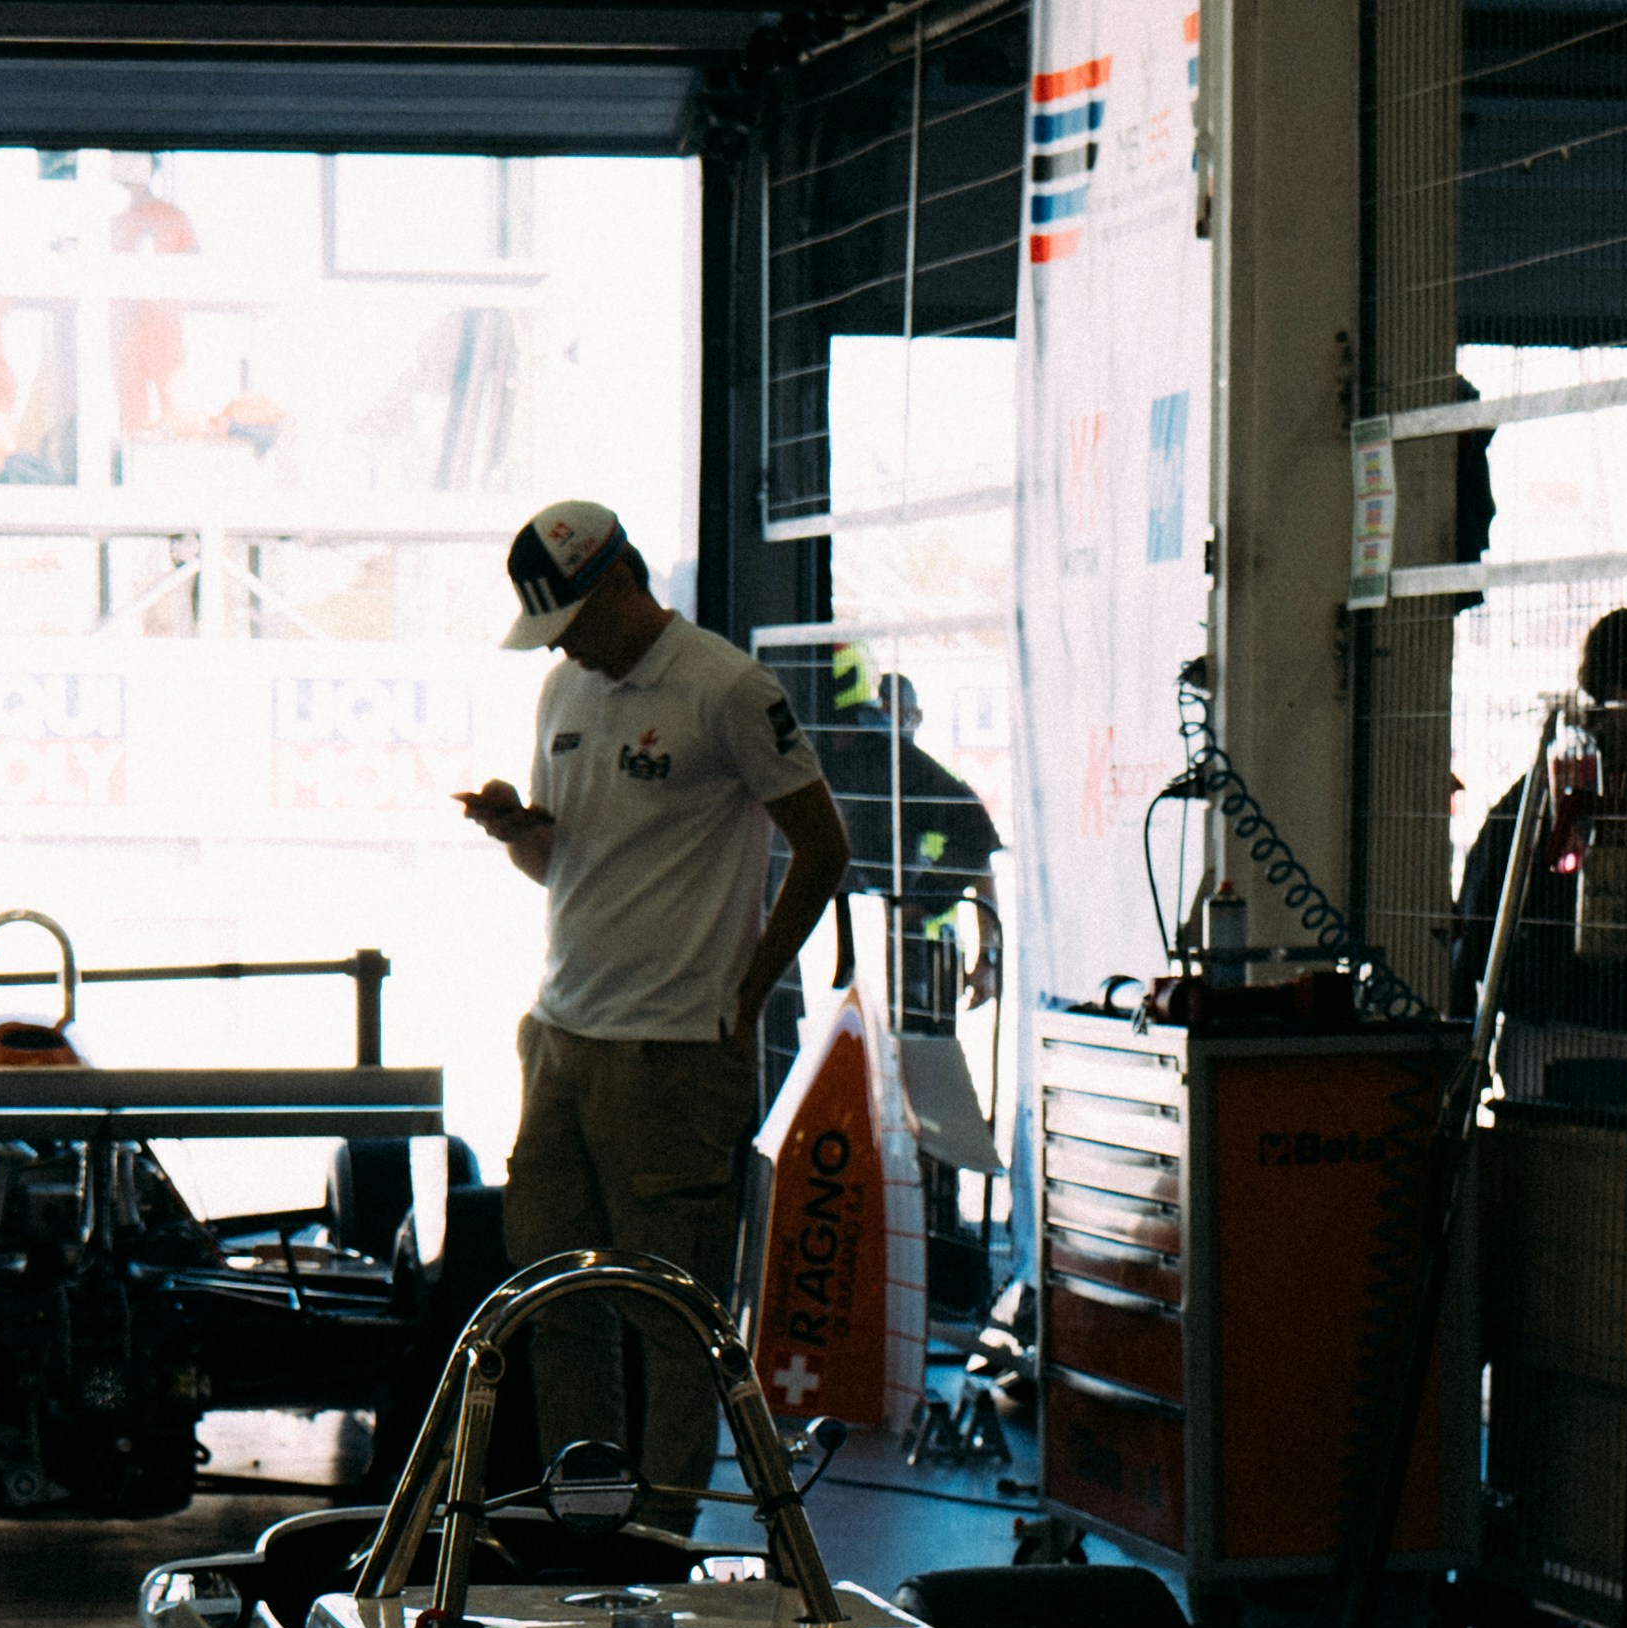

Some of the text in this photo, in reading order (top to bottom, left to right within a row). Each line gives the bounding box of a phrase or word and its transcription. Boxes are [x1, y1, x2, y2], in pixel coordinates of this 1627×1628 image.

[275, 679, 470, 740] LIQUI
[275, 745, 470, 808] MOLY
[1295, 1131, 1385, 1165] Beta
[789, 1130, 849, 1346] RAGNO
